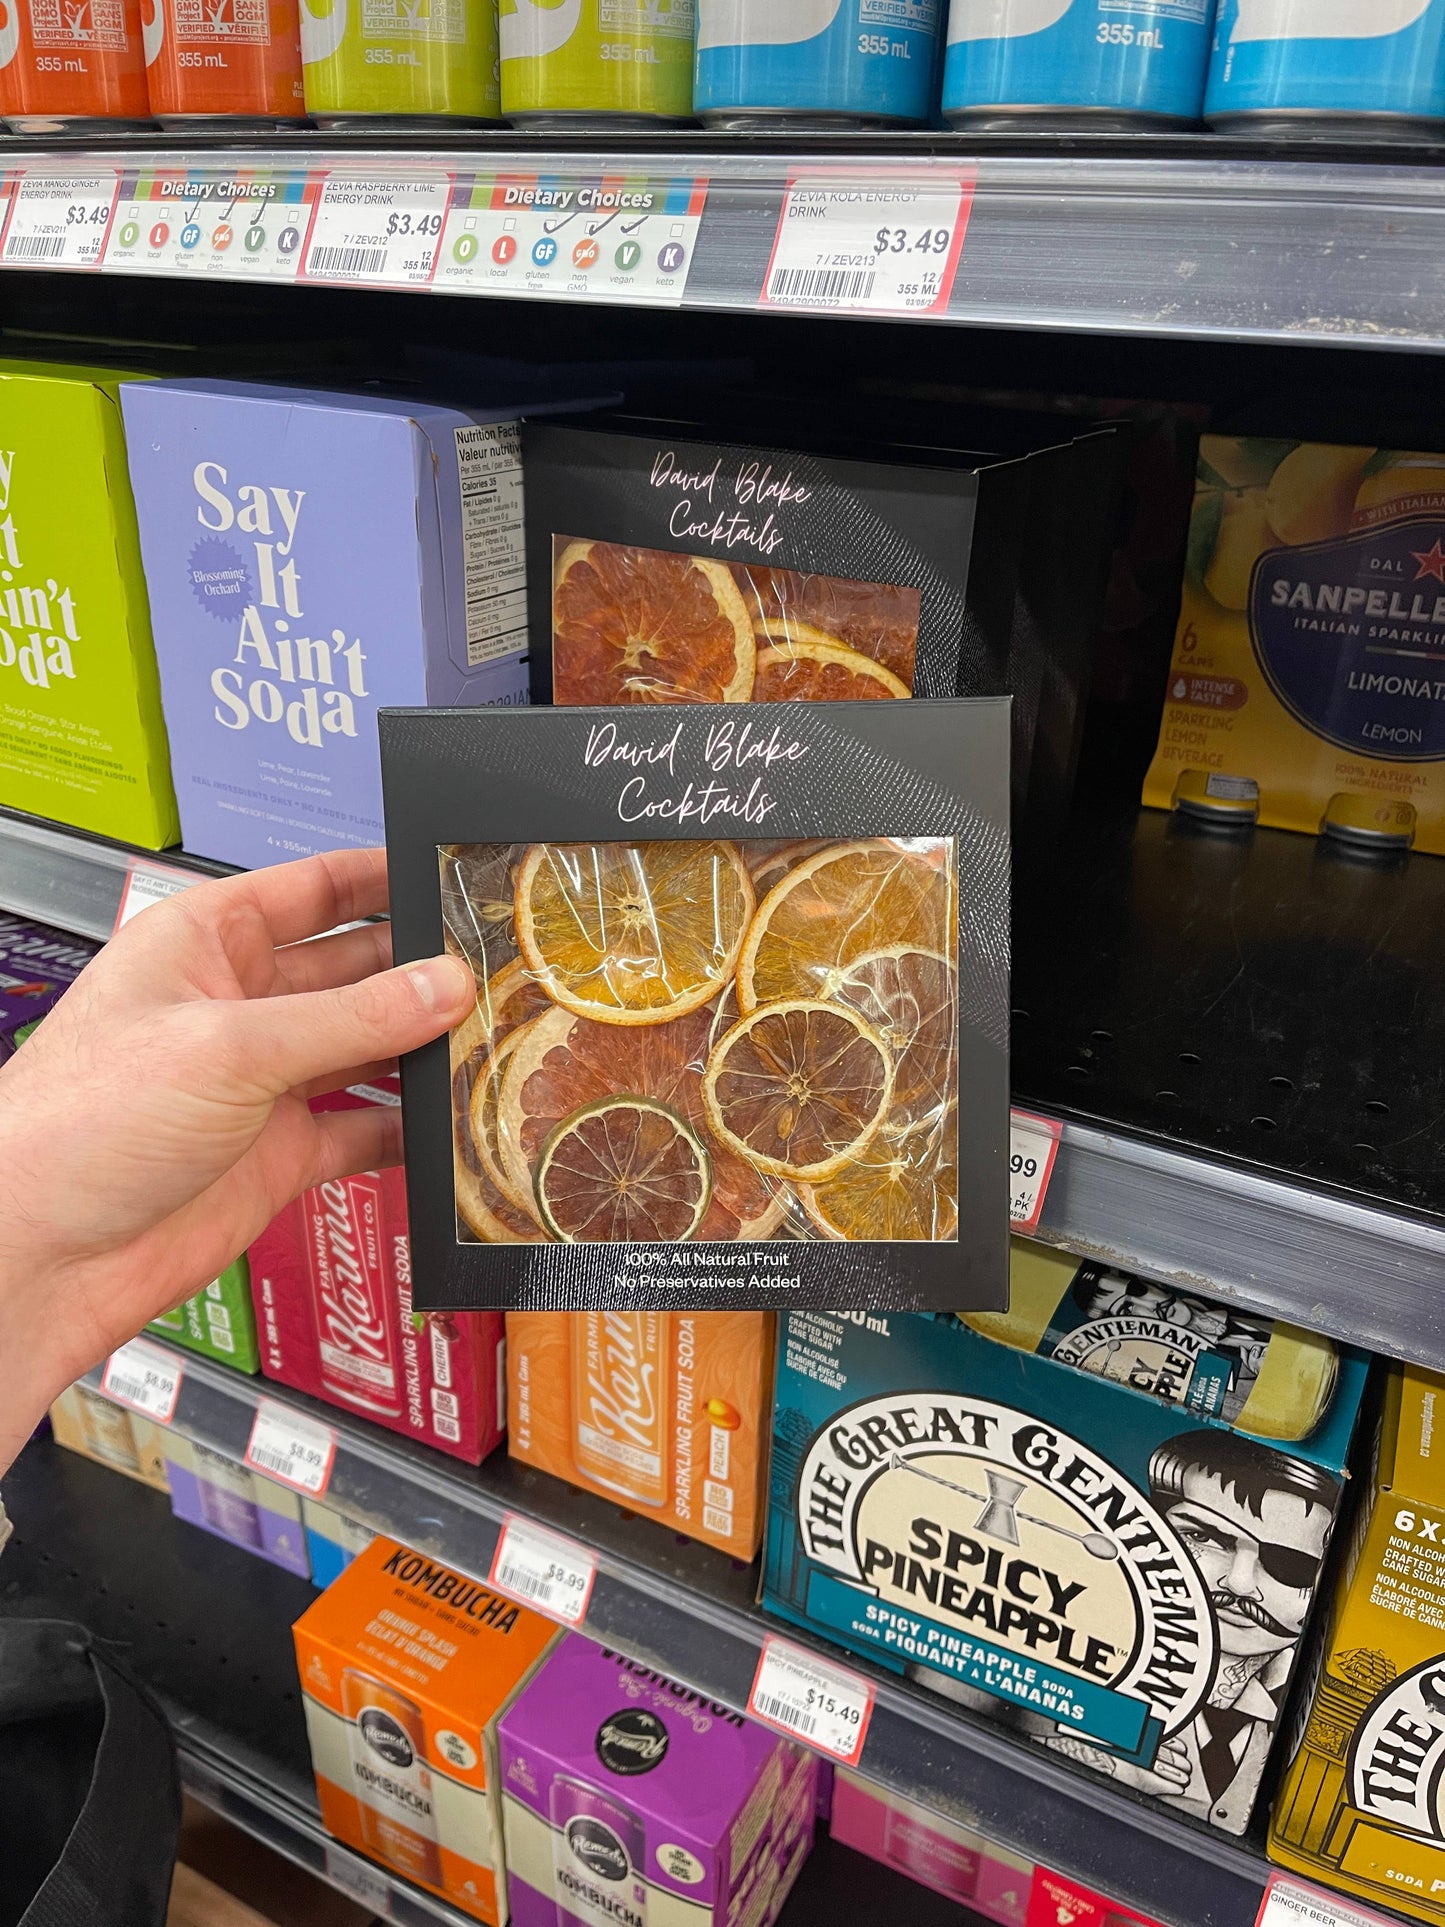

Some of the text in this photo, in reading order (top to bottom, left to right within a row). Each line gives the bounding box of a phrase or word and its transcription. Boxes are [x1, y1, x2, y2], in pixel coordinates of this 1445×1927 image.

[33, 9, 58, 18] GMO
[94, 9, 122, 20] SANS
[176, 2, 200, 12] GMO
[177, 11, 200, 20] Project
[236, 1, 264, 11] SANS
[236, 11, 264, 21] OGM
[366, 5, 394, 15] Project
[866, 0, 906, 14] VERIFIED
[34, 18, 59, 27] Project
[94, 19, 122, 29] OGM
[178, 24, 215, 32] VERIFIED
[366, 18, 409, 27] VERIFIED
[35, 30, 74, 39] VERIFIED
[1096, 22, 1163, 49] 355 mL
[600, 43, 660, 64] 355 mL
[857, 34, 911, 59] 355 mL
[36, 57, 88, 73] 355 mL
[178, 52, 228, 67] 355 mL
[364, 49, 422, 66] 355 mL
[44, 180, 100, 188] MANGO GINGER
[160, 181, 276, 199] Dietary Choices
[20, 191, 73, 199] ENERGY DRINK
[324, 194, 393, 205] ENERGY DRINK
[504, 188, 653, 208] Dietary Choices
[66, 205, 110, 225] $3.49
[788, 206, 827, 218] DRINK
[386, 212, 442, 236] $3.49
[355, 235, 388, 245] ZEV212
[873, 227, 949, 256] $3.49
[77, 246, 90, 255] 355
[535, 244, 553, 260] GF
[832, 255, 875, 266] ZEV213
[402, 261, 419, 270] 355
[446, 268, 674, 286] organic local gluten vegan keto
[922, 272, 936, 283] 12
[897, 284, 938, 295] 355 ML
[456, 424, 521, 445] Nutrition Facts
[459, 447, 488, 462] Valeur
[462, 480, 488, 491] Calories
[650, 450, 812, 507] David Blake
[193, 461, 306, 555] Say
[465, 528, 498, 541] Carbohydrate
[668, 500, 784, 555] Cocktails
[192, 567, 246, 584] Blossoming
[1370, 558, 1404, 573] DAL
[204, 582, 241, 597] Orchard
[253, 542, 304, 618] It
[466, 590, 486, 598] Sodium
[1294, 617, 1360, 636] ITALIAN
[1181, 622, 1197, 652] 6
[233, 603, 369, 698] Ain't
[1178, 656, 1214, 669] CANS
[1191, 680, 1235, 695] INTENSE
[210, 667, 358, 749] Soda
[1190, 691, 1223, 705] TASTE
[1169, 710, 1234, 732] SPARKLING
[1164, 729, 1208, 745] LEMON
[1361, 721, 1423, 743] LEMON
[584, 722, 810, 776] David Blake
[1162, 747, 1223, 768] BEVERAGE
[296, 768, 331, 783] Lavender
[1369, 767, 1428, 786] NATURAL
[617, 777, 778, 825] Cocktails
[1015, 1200, 1029, 1212] PK
[314, 1215, 330, 1288] FARMING
[367, 1227, 377, 1269] FRUIT
[623, 1252, 789, 1266] 100% All Natural Fruit
[321, 1180, 385, 1360] Karma
[614, 1275, 800, 1289] No Preservatives Added
[788, 1316, 842, 1346] CRAFTED WITH
[805, 1312, 844, 1335] ALCOHOLIC
[788, 1325, 833, 1352] CANE SUGAR
[1053, 1320, 1201, 1367] GENTLEMAN
[436, 1335, 446, 1381] CHERRY
[787, 1339, 839, 1369] NON ALCOOLISÉ
[786, 1349, 847, 1384] ÉLABORÉ AVEC DU
[786, 1358, 842, 1391] SUCRE DE CANNE
[144, 1370, 174, 1394] $8.99
[403, 1339, 424, 1428] SPARKLING
[675, 1319, 695, 1520] SPARKLING FRUIT SODA
[287, 1442, 322, 1468] $8.99
[712, 1433, 726, 1475] PEACH
[1394, 1509, 1416, 1532] 6
[1416, 1518, 1442, 1543] X
[1388, 1535, 1411, 1551] NON
[806, 1462, 850, 1556] THE
[828, 1406, 998, 1468] GREAT
[1011, 1425, 1199, 1714] GENTLEMAN
[909, 1517, 1088, 1619] SPICY
[1382, 1558, 1411, 1576] CANE
[1384, 1548, 1432, 1573] CRAFTED
[548, 1564, 585, 1591] $8.99
[1376, 1572, 1398, 1589] NON
[382, 1549, 520, 1635] KOMBUCHA
[1372, 1584, 1444, 1619] ÉLABORÉ AVEC
[863, 1538, 1117, 1680] PINEAPPLE
[1369, 1594, 1417, 1620] SUCRE DE
[377, 1609, 421, 1636] ORANGE
[866, 1605, 1074, 1699] SPICY PINEAPPLE SODA
[851, 1620, 880, 1638] SODA
[884, 1630, 967, 1673] PIQUANT
[985, 1671, 1085, 1720] L'ANANAS
[806, 1688, 860, 1725] $15.49
[1361, 1708, 1444, 1809] THE
[354, 1762, 432, 1816] KOMBUCHA
[571, 1834, 626, 1868] Remedy
[1385, 1868, 1425, 1888] SODA
[557, 1869, 644, 1927] KOMBUCHA
[1270, 1893, 1308, 1918] GINGER
[1310, 1910, 1336, 1927] BEER
